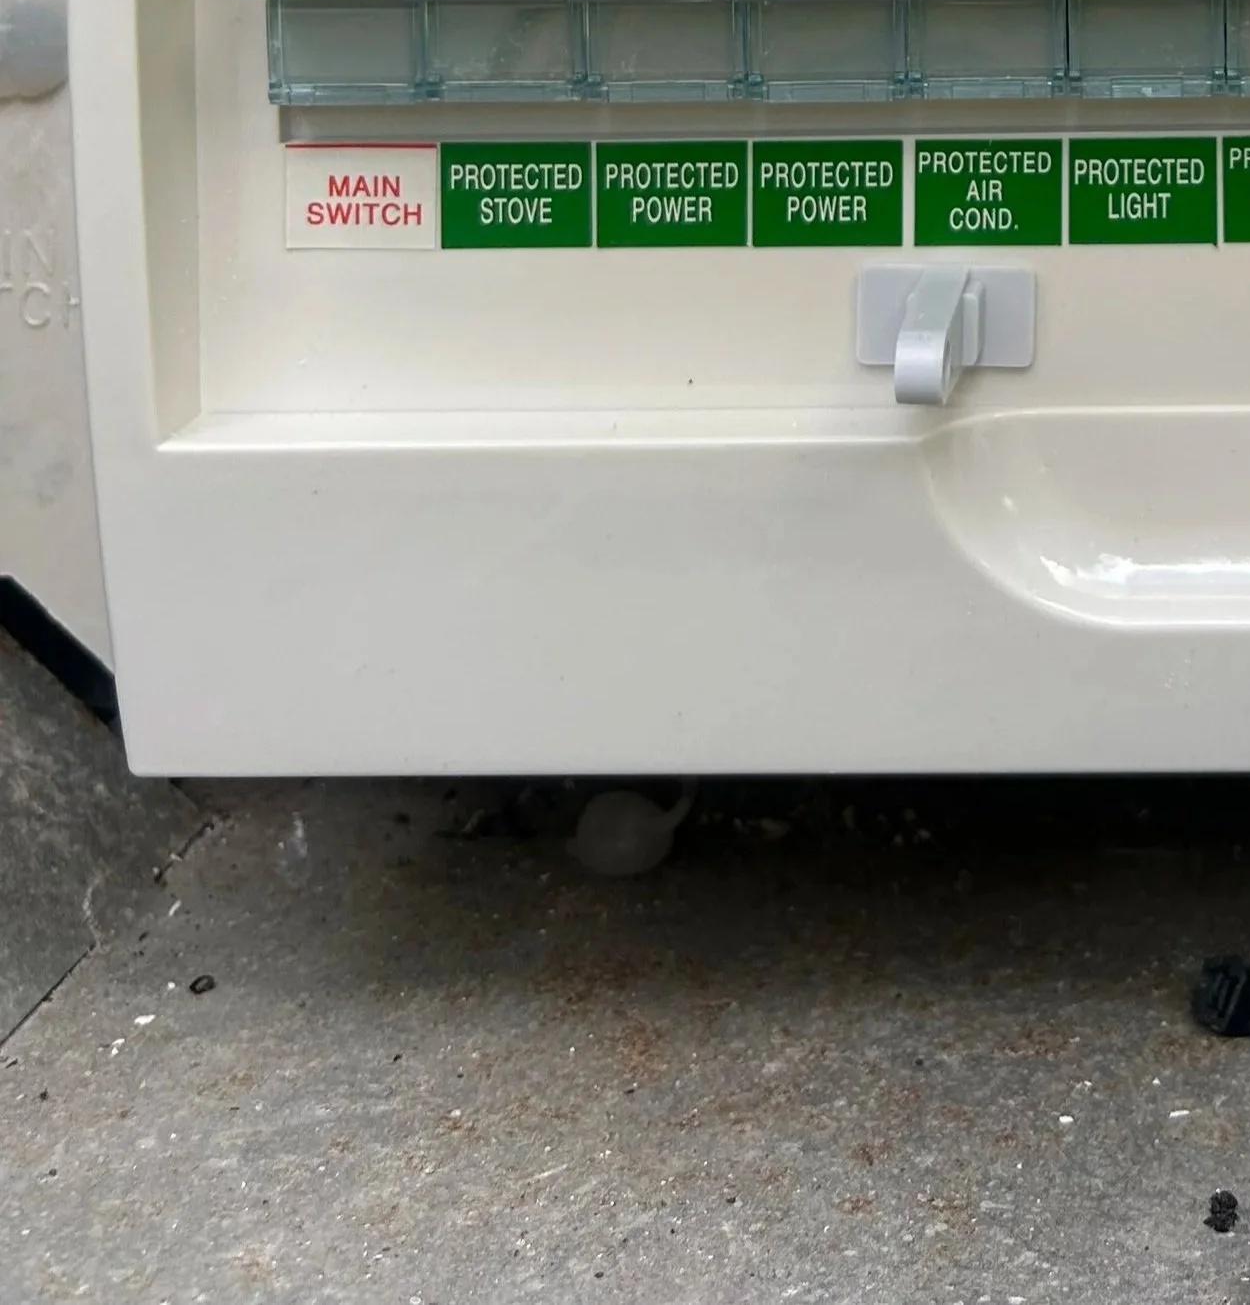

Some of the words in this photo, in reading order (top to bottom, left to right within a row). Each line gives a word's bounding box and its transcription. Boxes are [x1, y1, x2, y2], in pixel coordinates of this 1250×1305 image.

[605, 162, 738, 191] PROTECTED
[761, 161, 894, 190] PROTECTED
[918, 151, 1053, 176] PROTECTED
[1074, 158, 1206, 186] PROTECTED
[328, 175, 401, 198] MAIN
[450, 164, 583, 192] PROTECTED
[966, 179, 1004, 203] AIR
[306, 202, 422, 227] SWITCH
[479, 197, 553, 226] STOVE
[631, 196, 713, 225] POWER
[786, 195, 868, 224] POWER
[949, 206, 1019, 231] COND.
[1107, 192, 1172, 222] LIGHT
